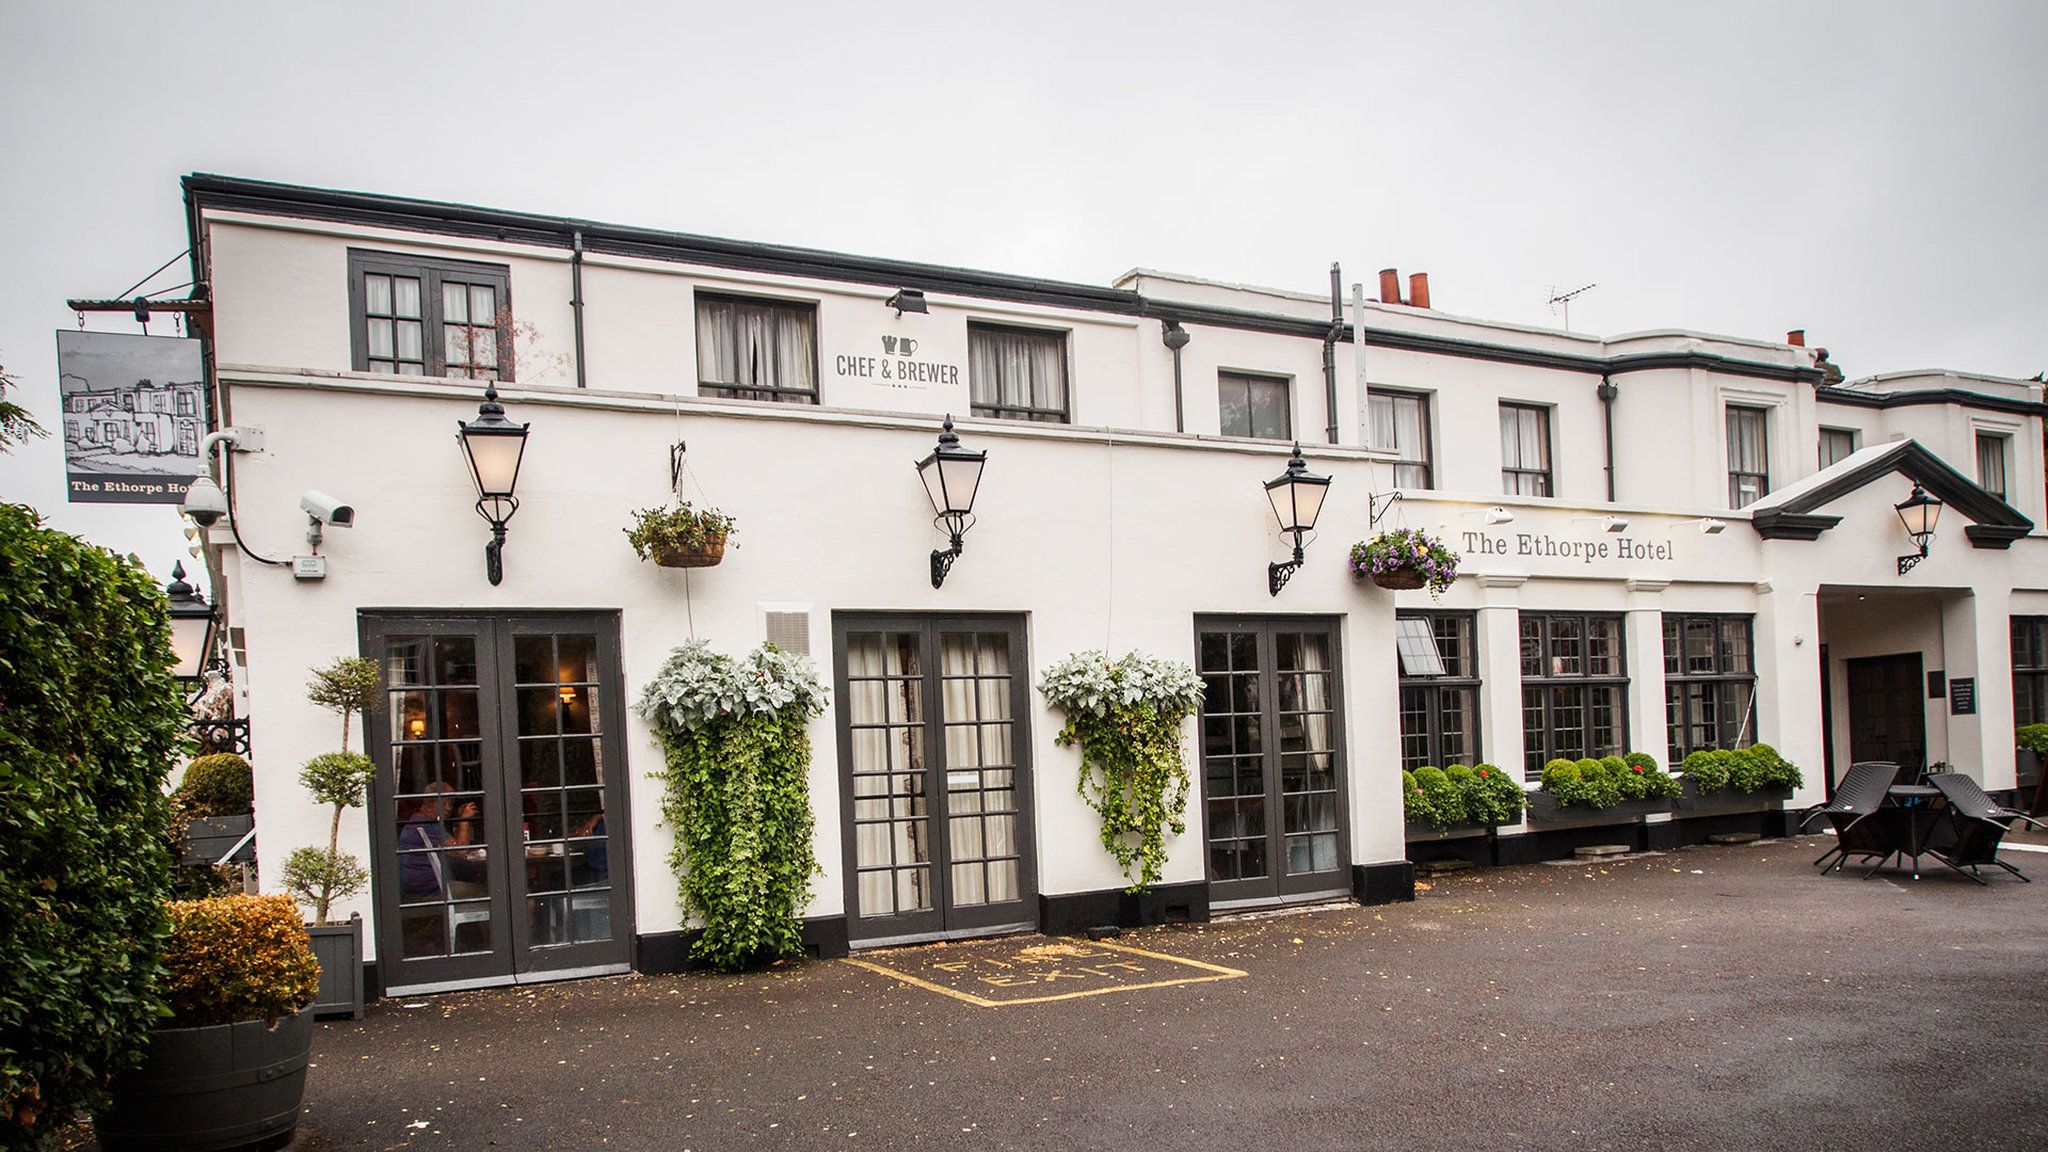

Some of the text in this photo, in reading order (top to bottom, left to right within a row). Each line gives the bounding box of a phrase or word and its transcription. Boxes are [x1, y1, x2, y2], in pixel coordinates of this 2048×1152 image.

[836, 355, 959, 385] CHEF & BREWER
[71, 481, 191, 495] The Ethorpe Ho
[1462, 532, 1674, 563] The Ethorpe Hotel
[979, 961, 1146, 987] EXIT
